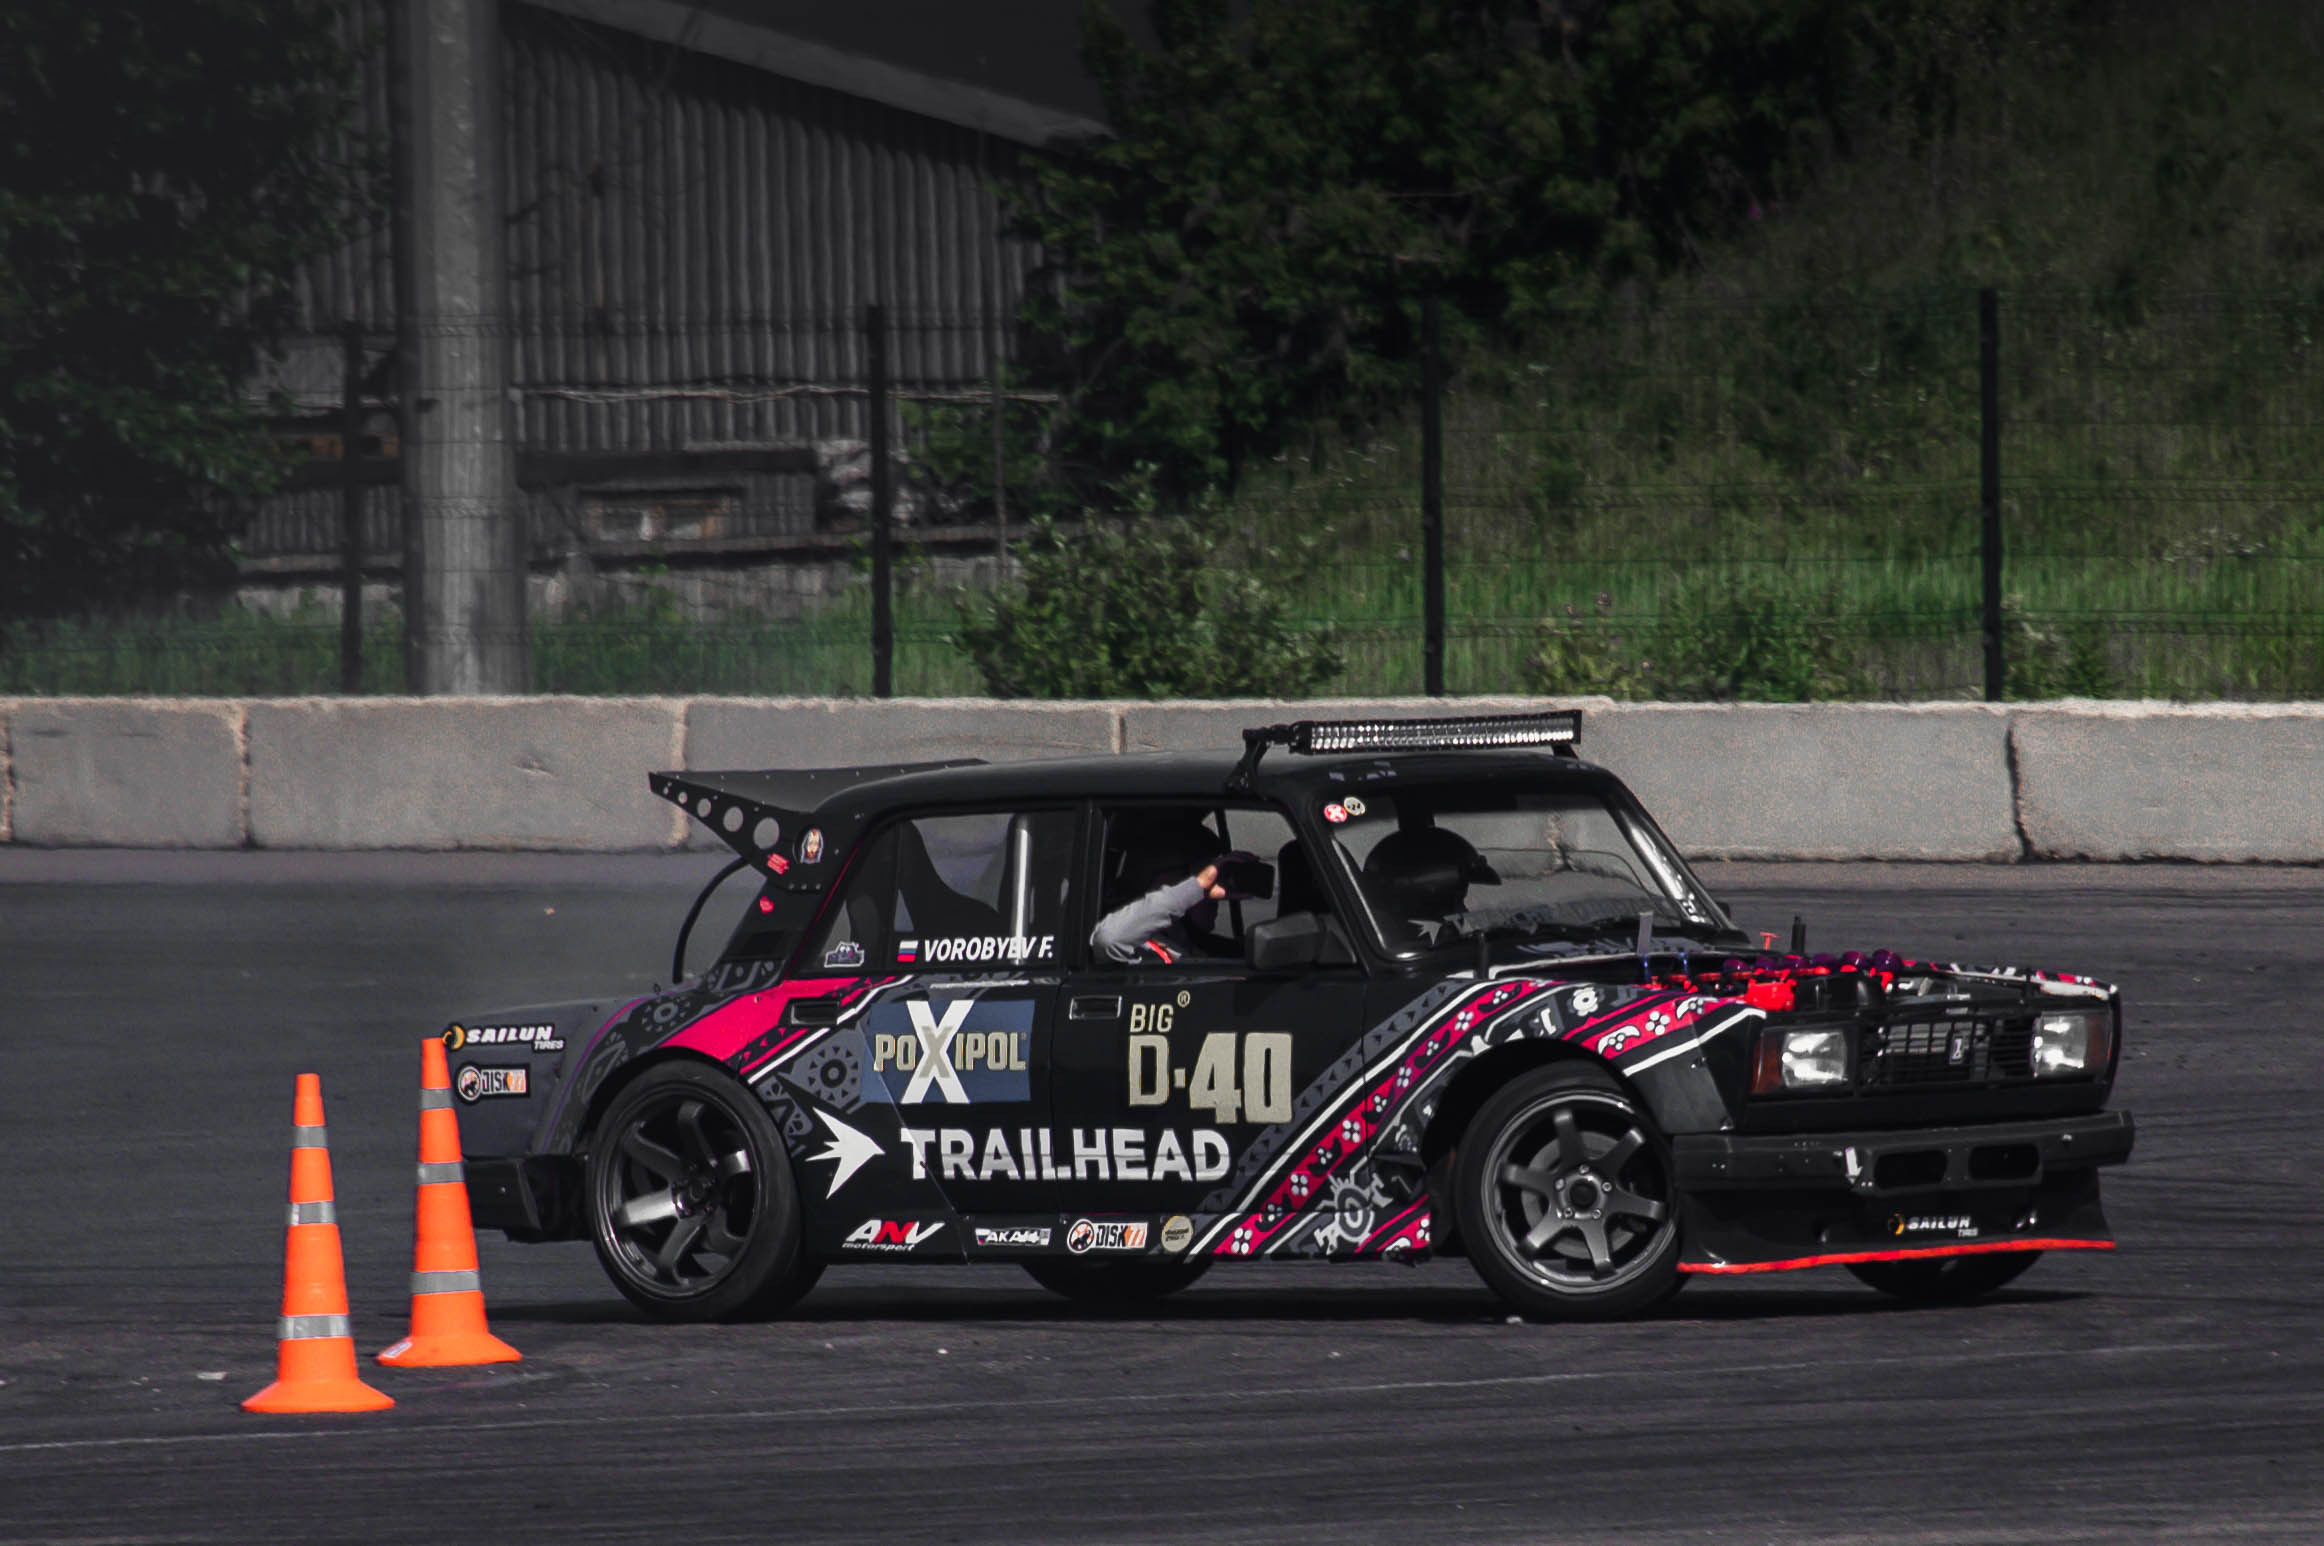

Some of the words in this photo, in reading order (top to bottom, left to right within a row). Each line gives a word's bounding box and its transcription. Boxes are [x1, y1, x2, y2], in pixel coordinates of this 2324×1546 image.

[924, 936, 1037, 963] VOROBYEV
[1038, 935, 1055, 959] F.
[466, 1026, 553, 1044] SAILUN
[534, 1040, 565, 1051] TIRES
[1129, 1032, 1293, 1124] D-40
[900, 1128, 1232, 1183] TRAILHEAD
[1907, 1215, 1971, 1230] SAILUN
[841, 1242, 915, 1252] motorsport
